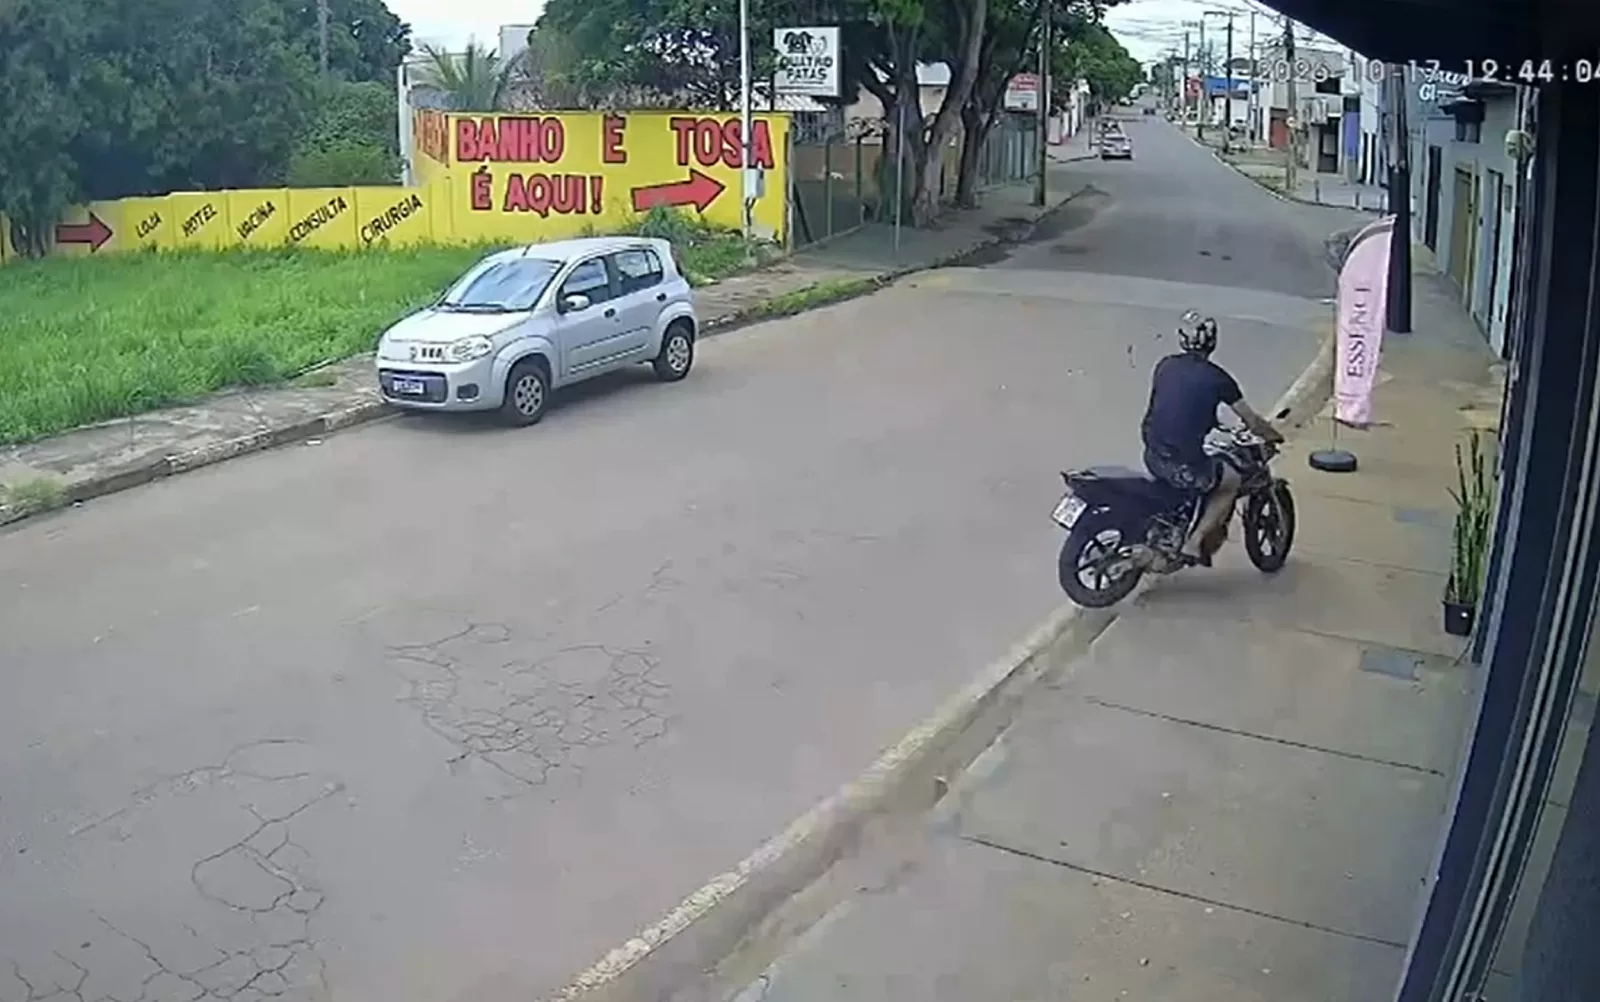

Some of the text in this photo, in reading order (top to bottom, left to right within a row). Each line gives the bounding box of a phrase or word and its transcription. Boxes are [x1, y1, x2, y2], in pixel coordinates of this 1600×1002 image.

[787, 68, 827, 80] PATAS
[457, 117, 564, 163] BANHO
[670, 117, 774, 168] TOSA
[471, 165, 603, 218] É AQUI!
[135, 211, 162, 239] LOJA
[181, 203, 217, 237] HOTEL
[237, 200, 276, 239] VACINA
[289, 195, 348, 242] CONSULTA
[361, 193, 423, 243] CIRURGIA
